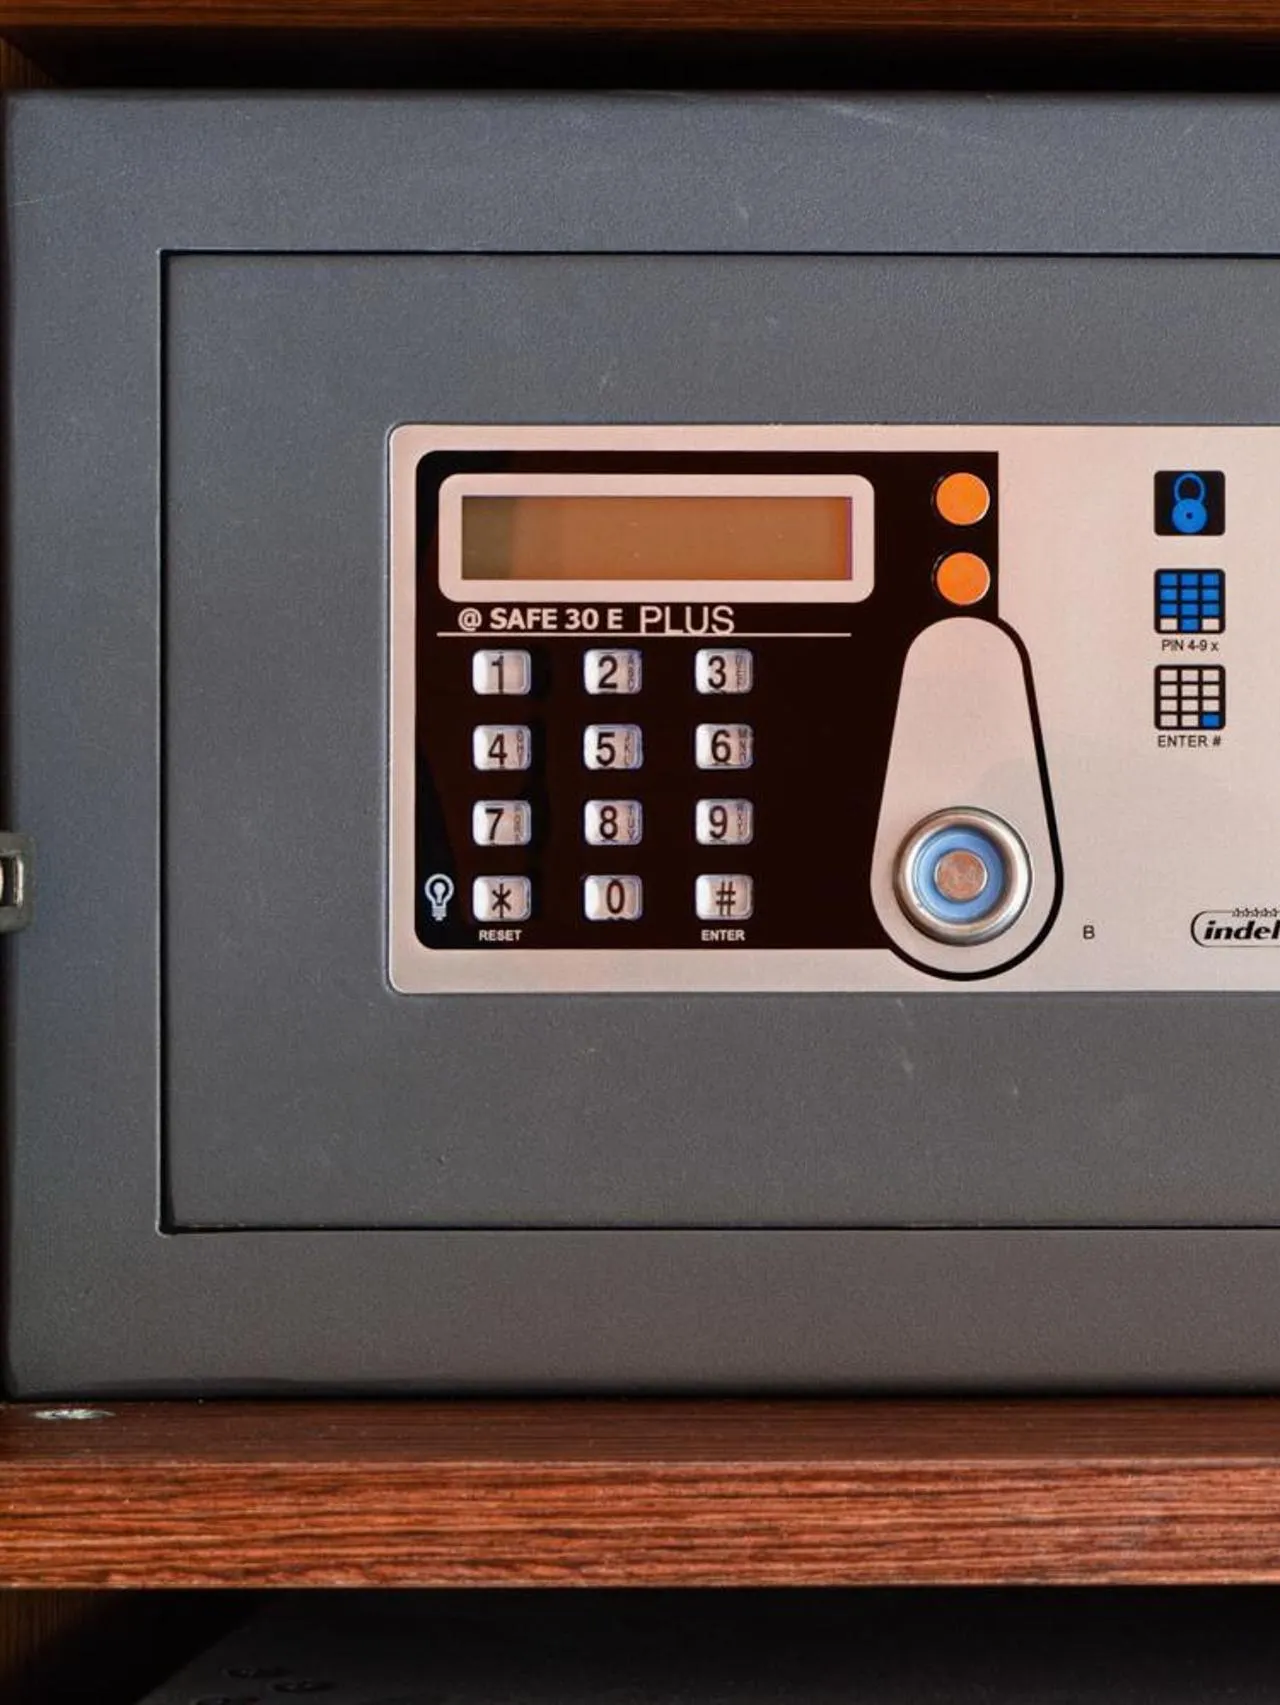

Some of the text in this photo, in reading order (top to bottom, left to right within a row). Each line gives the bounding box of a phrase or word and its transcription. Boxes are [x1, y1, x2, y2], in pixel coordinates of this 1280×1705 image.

[490, 608, 558, 630] SAFE
[565, 608, 600, 630] 30
[607, 608, 623, 630] E
[640, 605, 735, 633] PLUS
[1161, 638, 1185, 652] PIN
[1187, 638, 1208, 652] 4-9
[491, 655, 505, 693] 1
[598, 655, 618, 689] 2
[708, 655, 726, 690] 3
[488, 732, 508, 766] 4
[596, 731, 616, 766] 5
[710, 729, 731, 764] 6
[1157, 734, 1222, 748] ENTER #
[485, 808, 505, 842] 7
[599, 805, 618, 840] 8
[709, 805, 728, 839] 9
[606, 879, 625, 915] 0
[716, 881, 736, 917] #
[478, 929, 523, 942] RESET
[701, 929, 746, 942] ENTER
[1082, 924, 1096, 940] B
